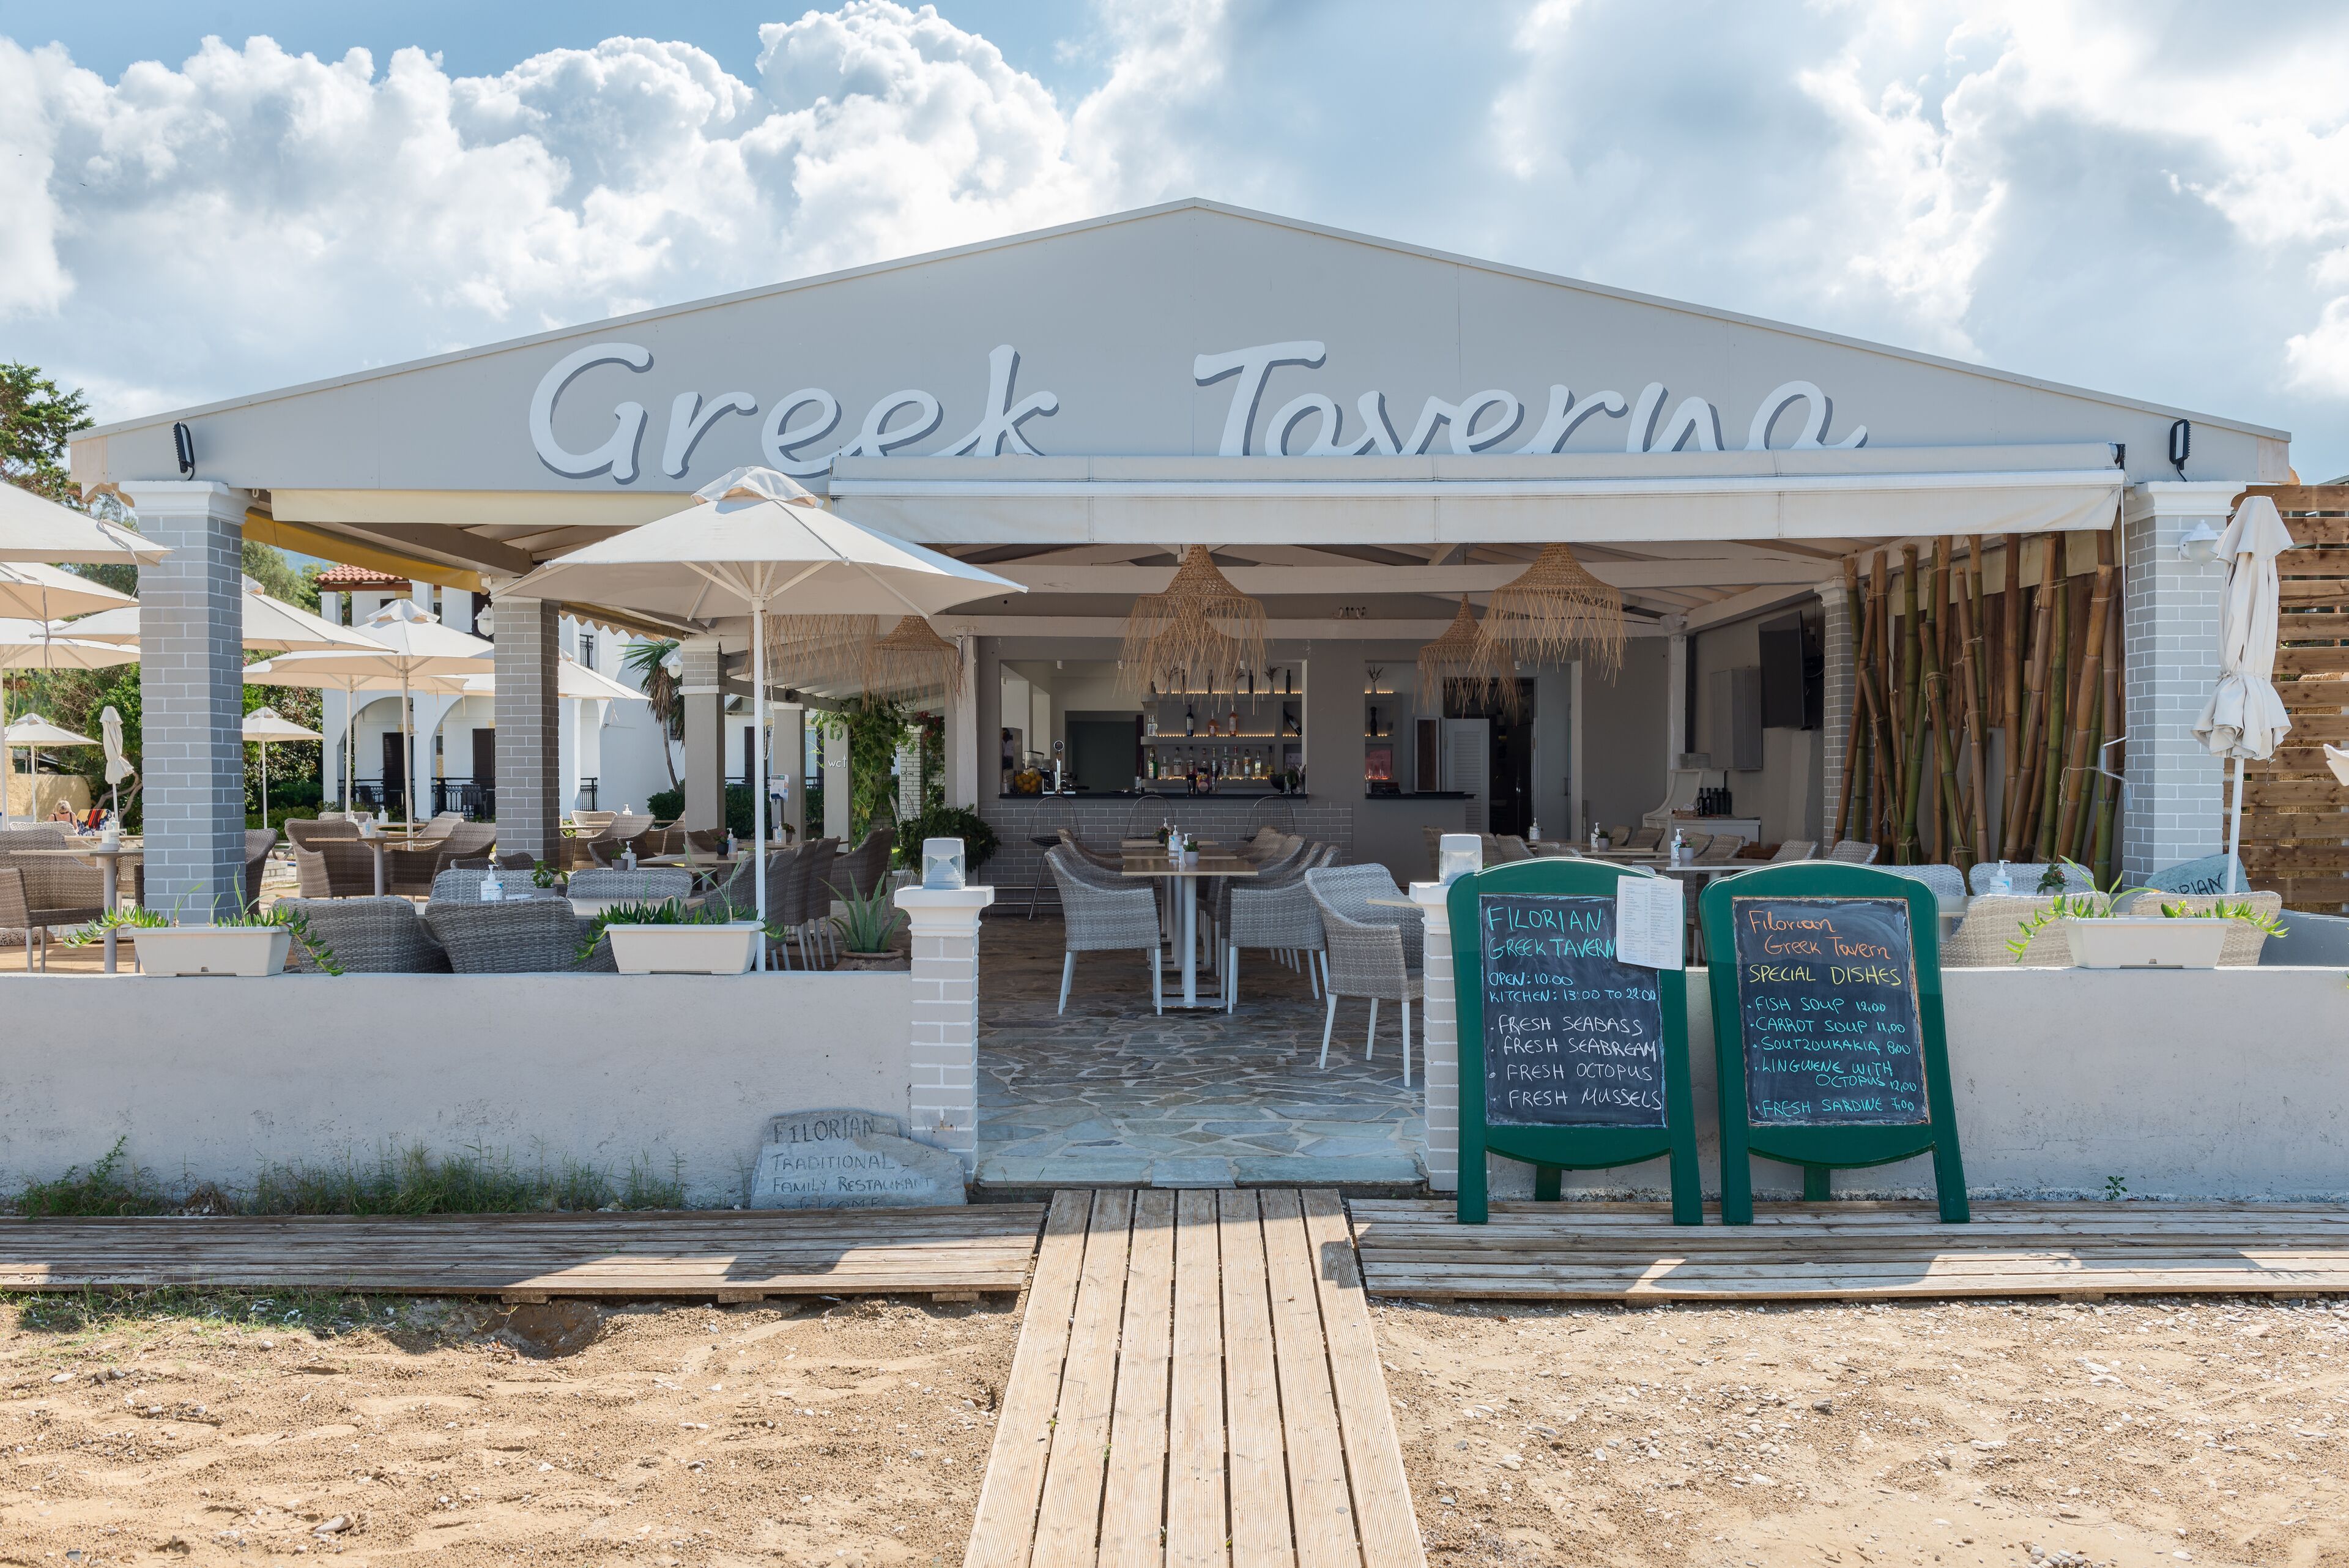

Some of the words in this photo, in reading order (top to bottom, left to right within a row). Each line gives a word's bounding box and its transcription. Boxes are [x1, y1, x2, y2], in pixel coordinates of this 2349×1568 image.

[529, 343, 1058, 485] Greek
[1193, 340, 1867, 458] Taverna
[1488, 906, 1603, 934] FILORIAN
[1748, 910, 1837, 934] Filorian
[1488, 937, 1546, 960] GREEK
[1764, 934, 1822, 955] Greek
[1825, 936, 1891, 959] Tavern
[1535, 973, 1573, 986] 10:00
[1748, 964, 1817, 983] SPECIAL
[1830, 965, 1902, 986] DISHES
[1564, 989, 1601, 1002] 13:00
[1604, 989, 1623, 1000] TO
[1755, 995, 1791, 1011] FISH
[1800, 998, 1845, 1014] SOUP
[1499, 1014, 1551, 1035] FRESH
[1562, 1016, 1643, 1037] SEABASS
[1756, 1017, 1815, 1033] CARROT
[1825, 1020, 1868, 1034] SOUP
[1504, 1035, 1559, 1055] FRESH
[1568, 1038, 1657, 1063] SEABREAM
[1507, 1064, 1565, 1081] FRESH
[1576, 1063, 1653, 1082] OCTOPUS
[1852, 1060, 1894, 1077] WITH
[1815, 1074, 1886, 1088] OCTOPUS
[1508, 1090, 1568, 1109] FRESH
[1581, 1088, 1662, 1110] MUSSELS
[1762, 1100, 1812, 1118] FRESH
[1822, 1097, 1883, 1113] SARDINE
[773, 1116, 875, 1144] FILORIAN
[771, 1152, 896, 1171] TRADITIONAL
[773, 1176, 828, 1194] FAMILY
